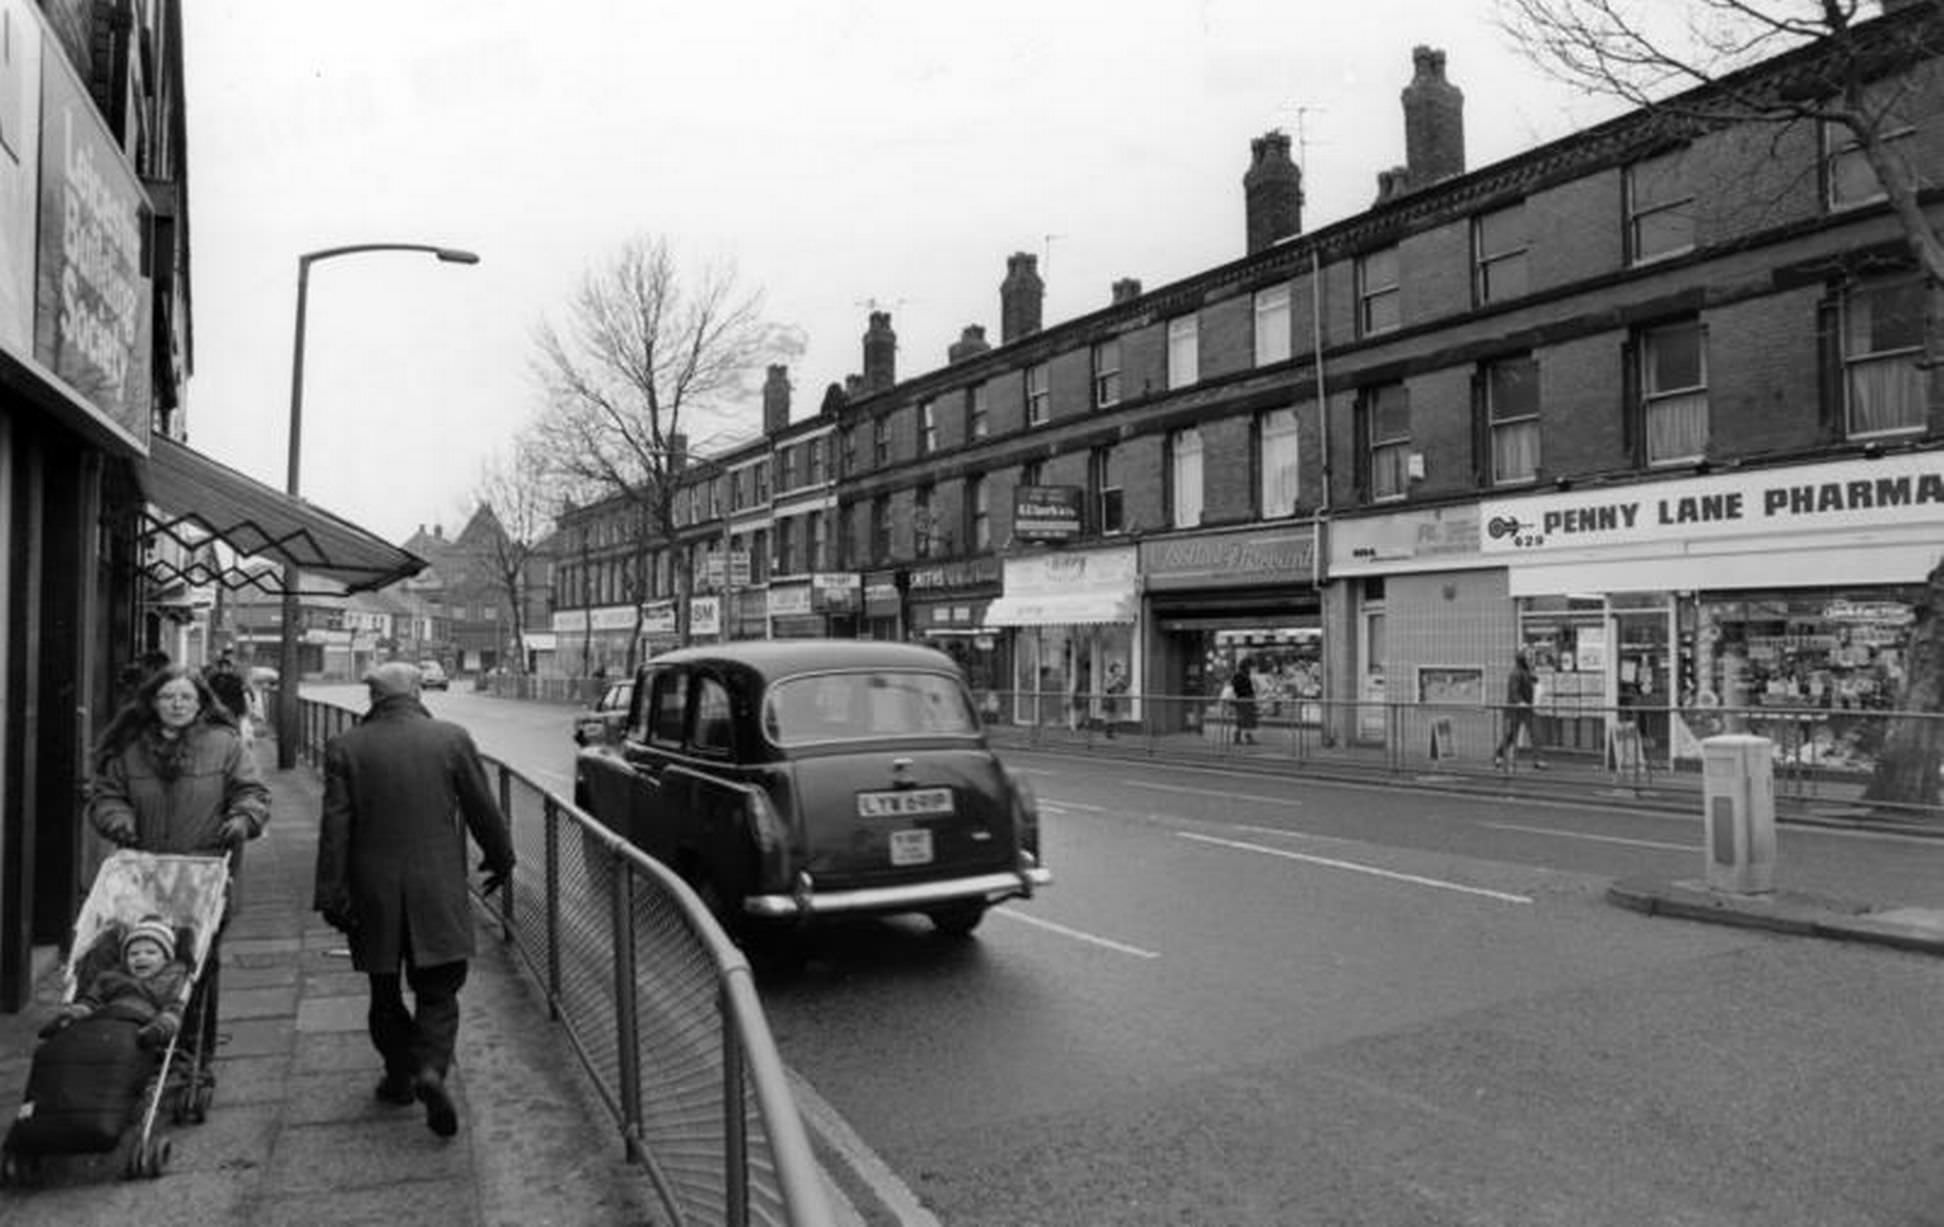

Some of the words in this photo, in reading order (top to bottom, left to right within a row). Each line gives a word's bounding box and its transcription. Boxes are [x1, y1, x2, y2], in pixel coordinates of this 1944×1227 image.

[60, 266, 127, 401] Society
[64, 186, 136, 346] Building
[1543, 503, 1639, 534] PENNY
[1658, 493, 1743, 525] LANE
